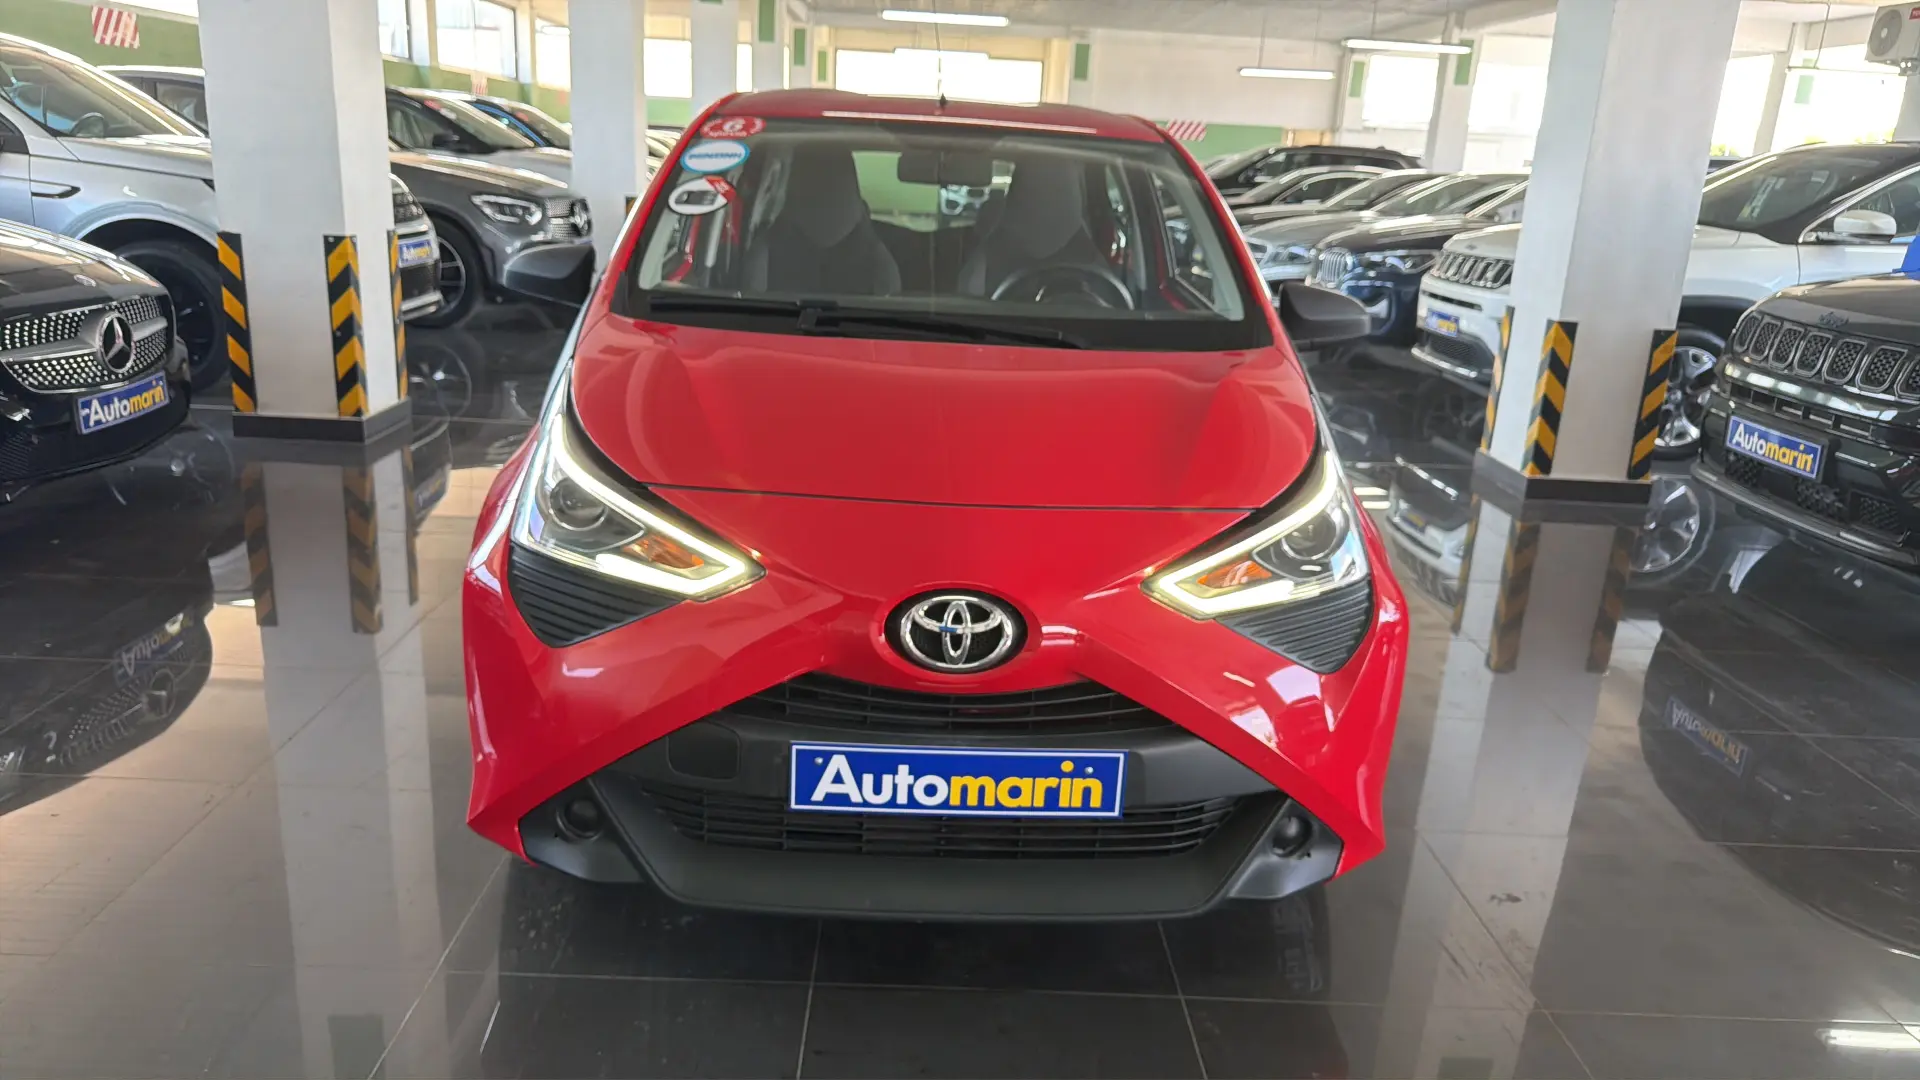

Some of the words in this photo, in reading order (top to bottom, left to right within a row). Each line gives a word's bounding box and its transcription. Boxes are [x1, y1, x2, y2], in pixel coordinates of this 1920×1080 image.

[88, 380, 165, 428] Automarin
[1732, 422, 1813, 473] Automarin
[810, 754, 1103, 809] Automarin
